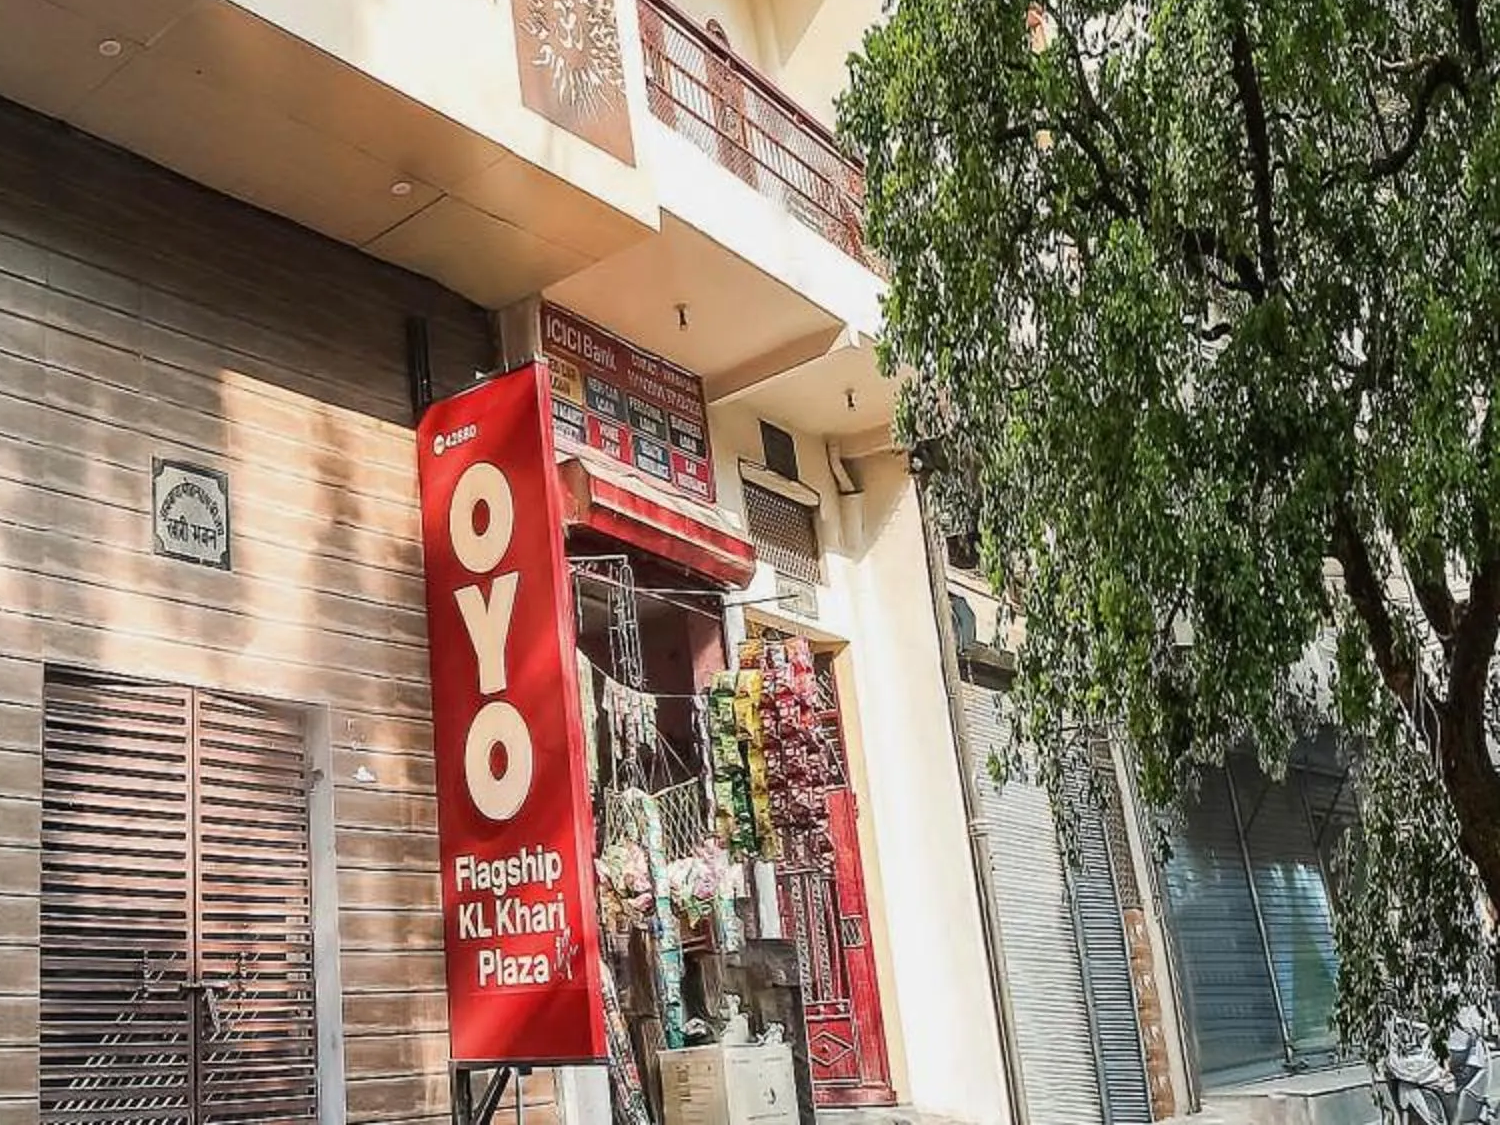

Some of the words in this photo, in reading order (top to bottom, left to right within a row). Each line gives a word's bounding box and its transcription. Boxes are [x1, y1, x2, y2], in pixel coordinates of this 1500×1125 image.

[546, 315, 582, 353] ICICI
[583, 335, 617, 372] Bank
[449, 461, 533, 821] OYO
[455, 844, 562, 895] Flagship
[458, 901, 493, 940] KL
[496, 893, 566, 936] Khari
[478, 949, 550, 987] Plaza
